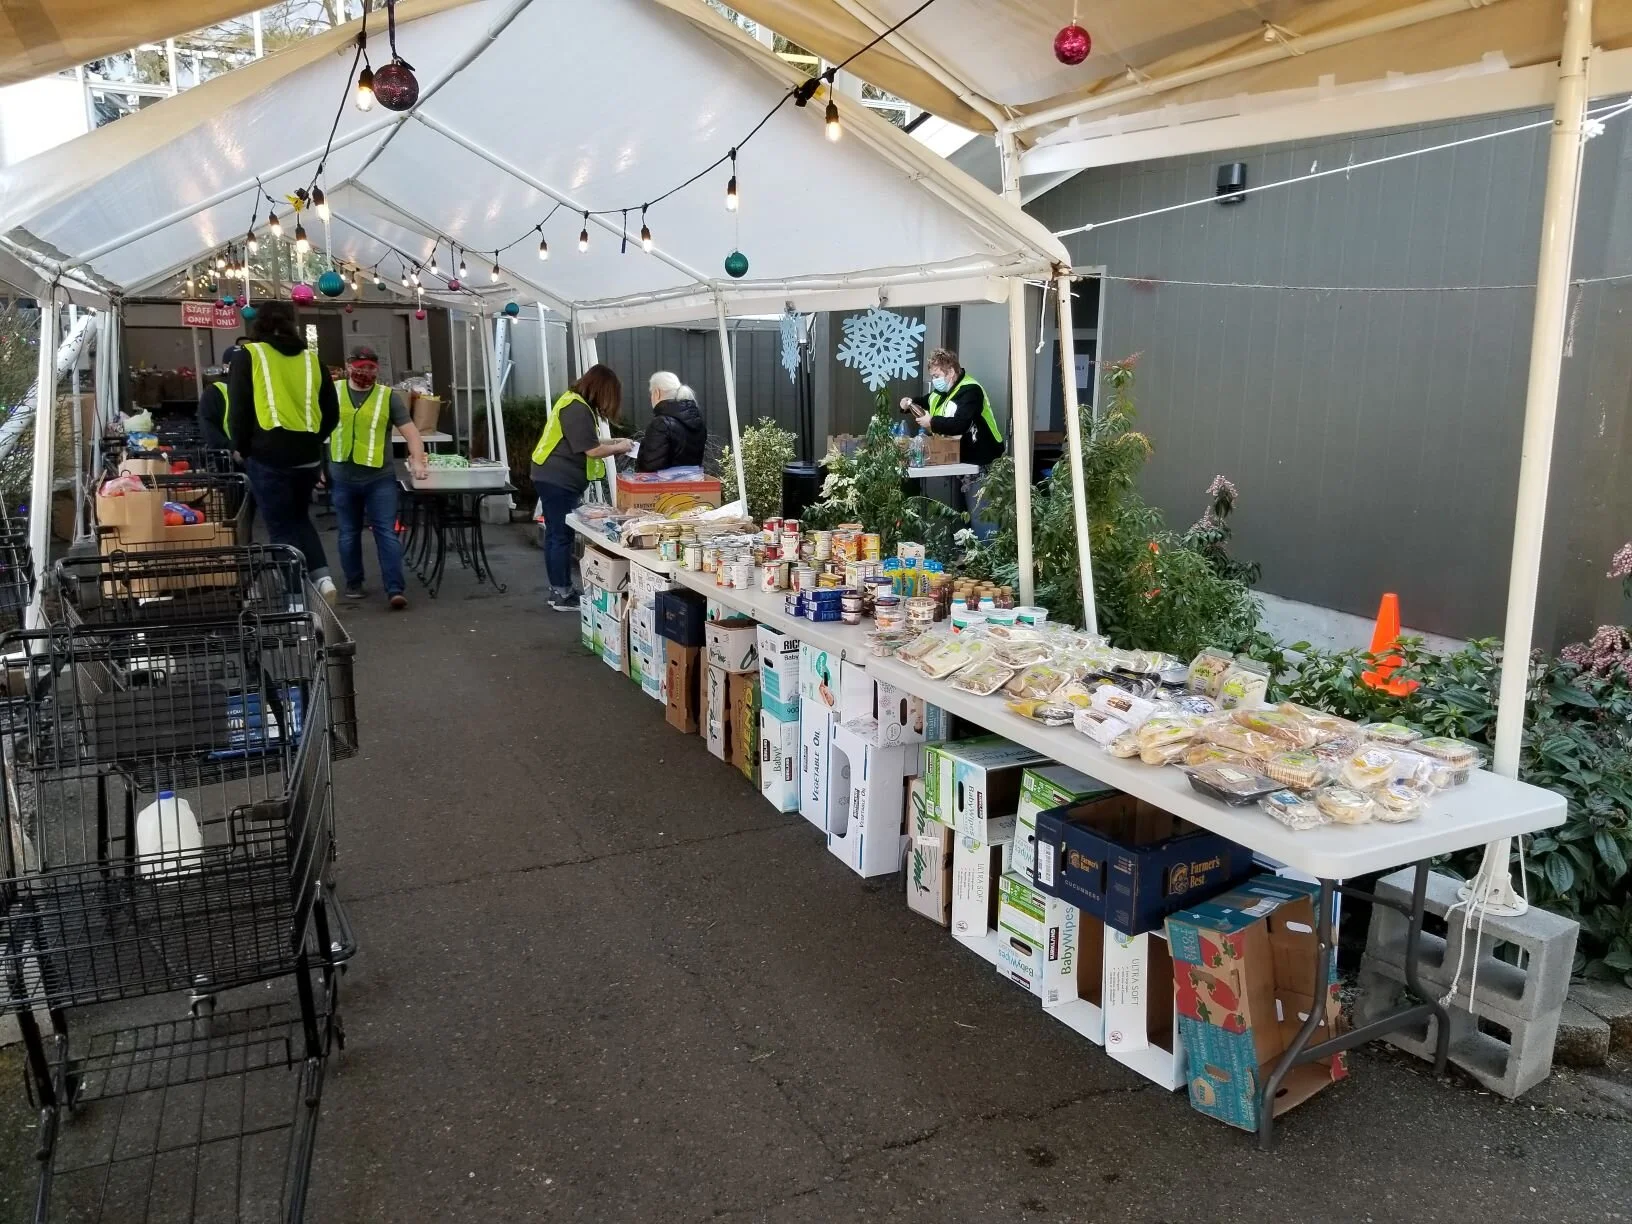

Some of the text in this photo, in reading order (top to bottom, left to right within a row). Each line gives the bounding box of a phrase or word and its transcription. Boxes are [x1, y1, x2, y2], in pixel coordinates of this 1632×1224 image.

[186, 305, 210, 314] STAFF
[187, 316, 210, 324] ONLY
[215, 308, 235, 316] STAFF
[216, 318, 236, 326] ONLY
[812, 731, 820, 802] VEGETABLE OIL
[967, 785, 976, 837] BabyWipes
[1079, 863, 1090, 873] Best
[1080, 855, 1099, 870] Farmer's
[1190, 855, 1221, 875] Farmer's
[976, 863, 985, 903] ULTRA SOFT
[1064, 879, 1101, 902] CUCUMBERS
[1189, 873, 1206, 889] Best
[1049, 928, 1057, 960] KIRKLAND
[1061, 906, 1077, 976] BabyWipes
[998, 948, 1034, 978] BabyWipes
[1131, 958, 1140, 1006] ULTRA SOFT
